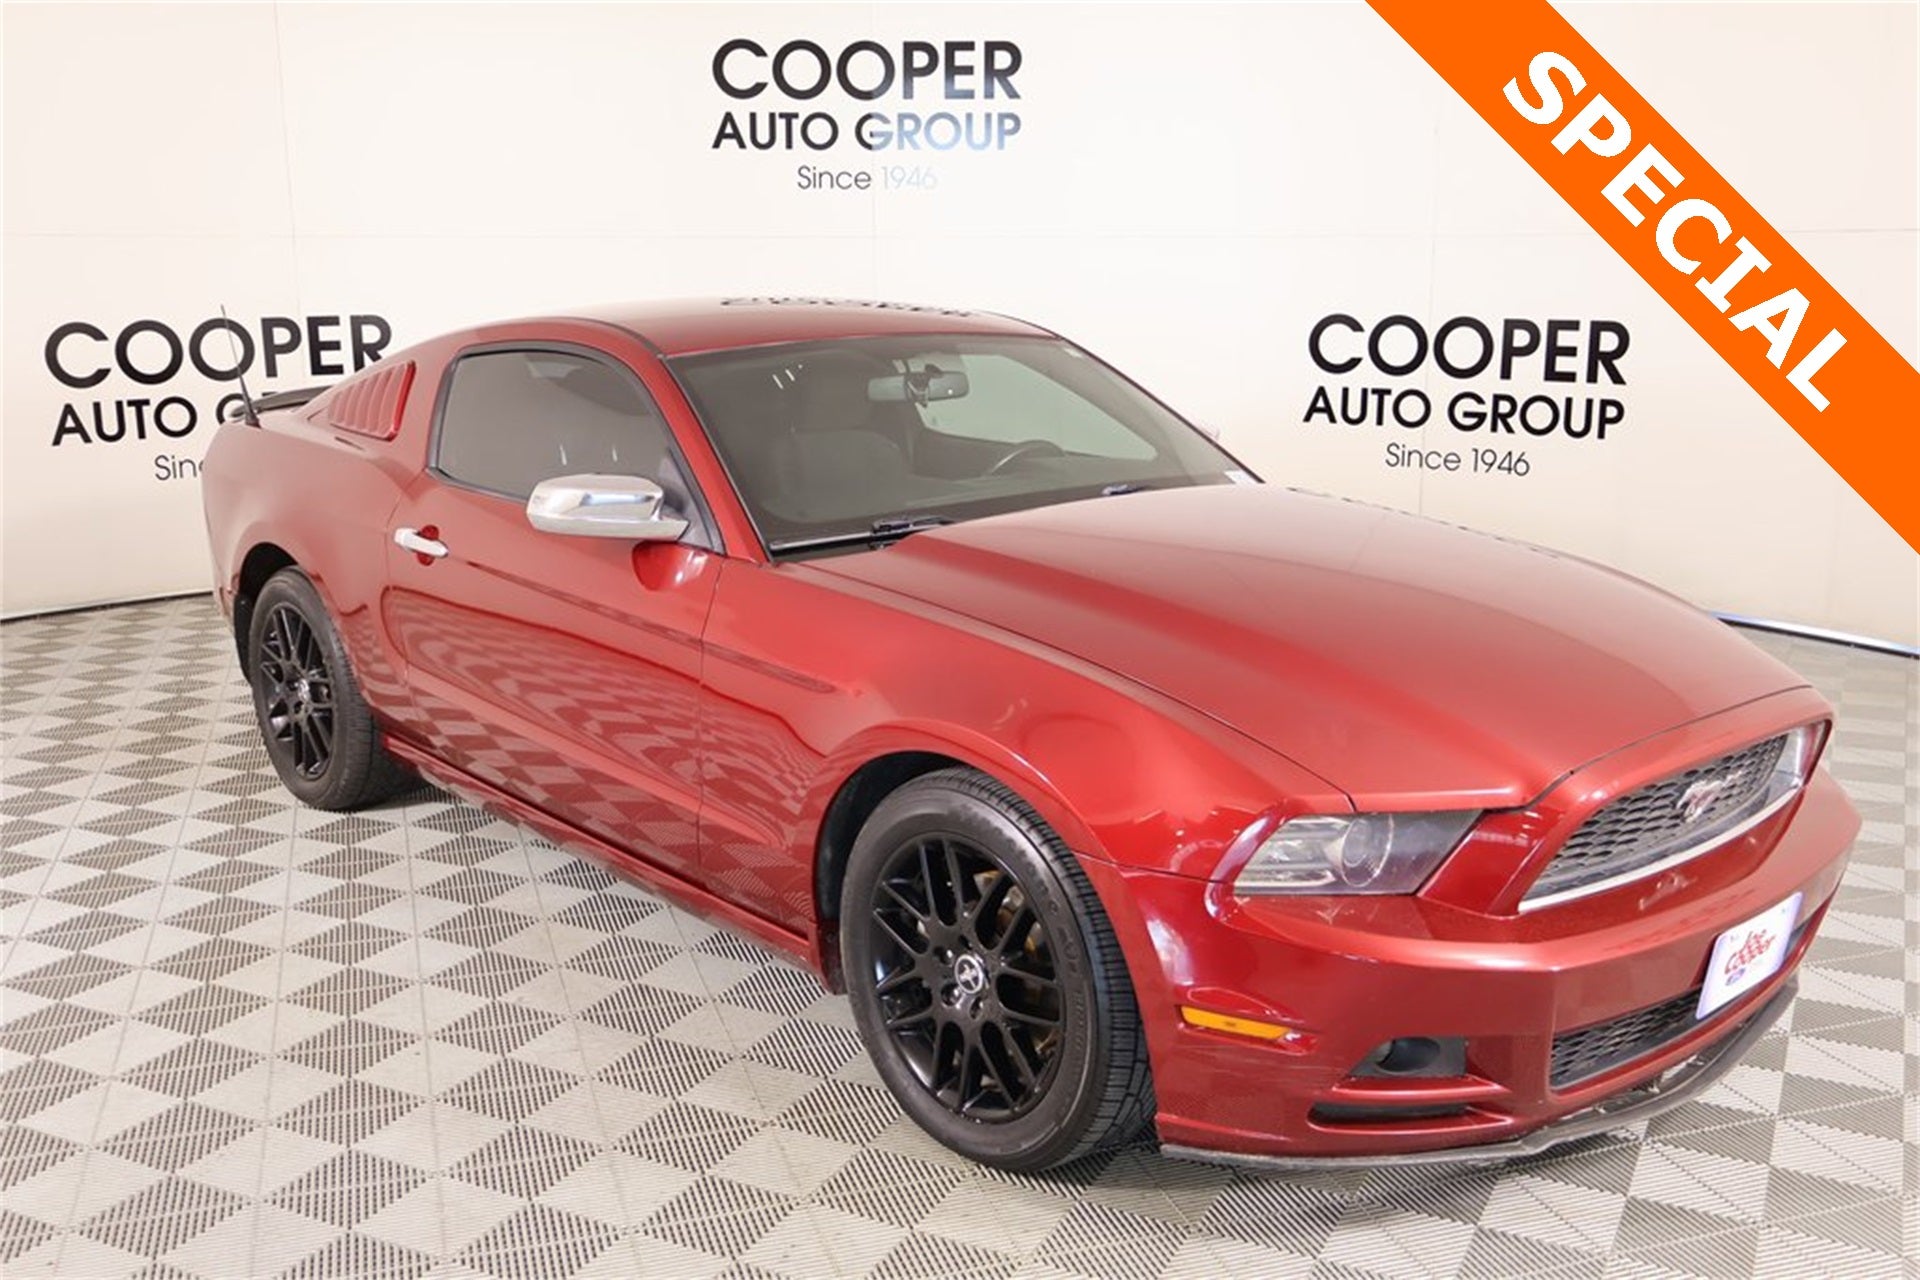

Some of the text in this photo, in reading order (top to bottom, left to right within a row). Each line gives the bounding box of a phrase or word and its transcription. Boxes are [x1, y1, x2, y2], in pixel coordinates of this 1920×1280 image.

[711, 38, 1023, 101] COOPER
[711, 111, 1022, 151] AUTO GROUP
[797, 165, 938, 190] Since 1946
[45, 315, 392, 389] COOPER
[1308, 313, 1631, 385] COOPER
[51, 396, 198, 446] AUTO
[1302, 386, 1626, 440] AUTO GROUP
[154, 455, 203, 481] Sin
[1385, 442, 1531, 477] Since 1946
